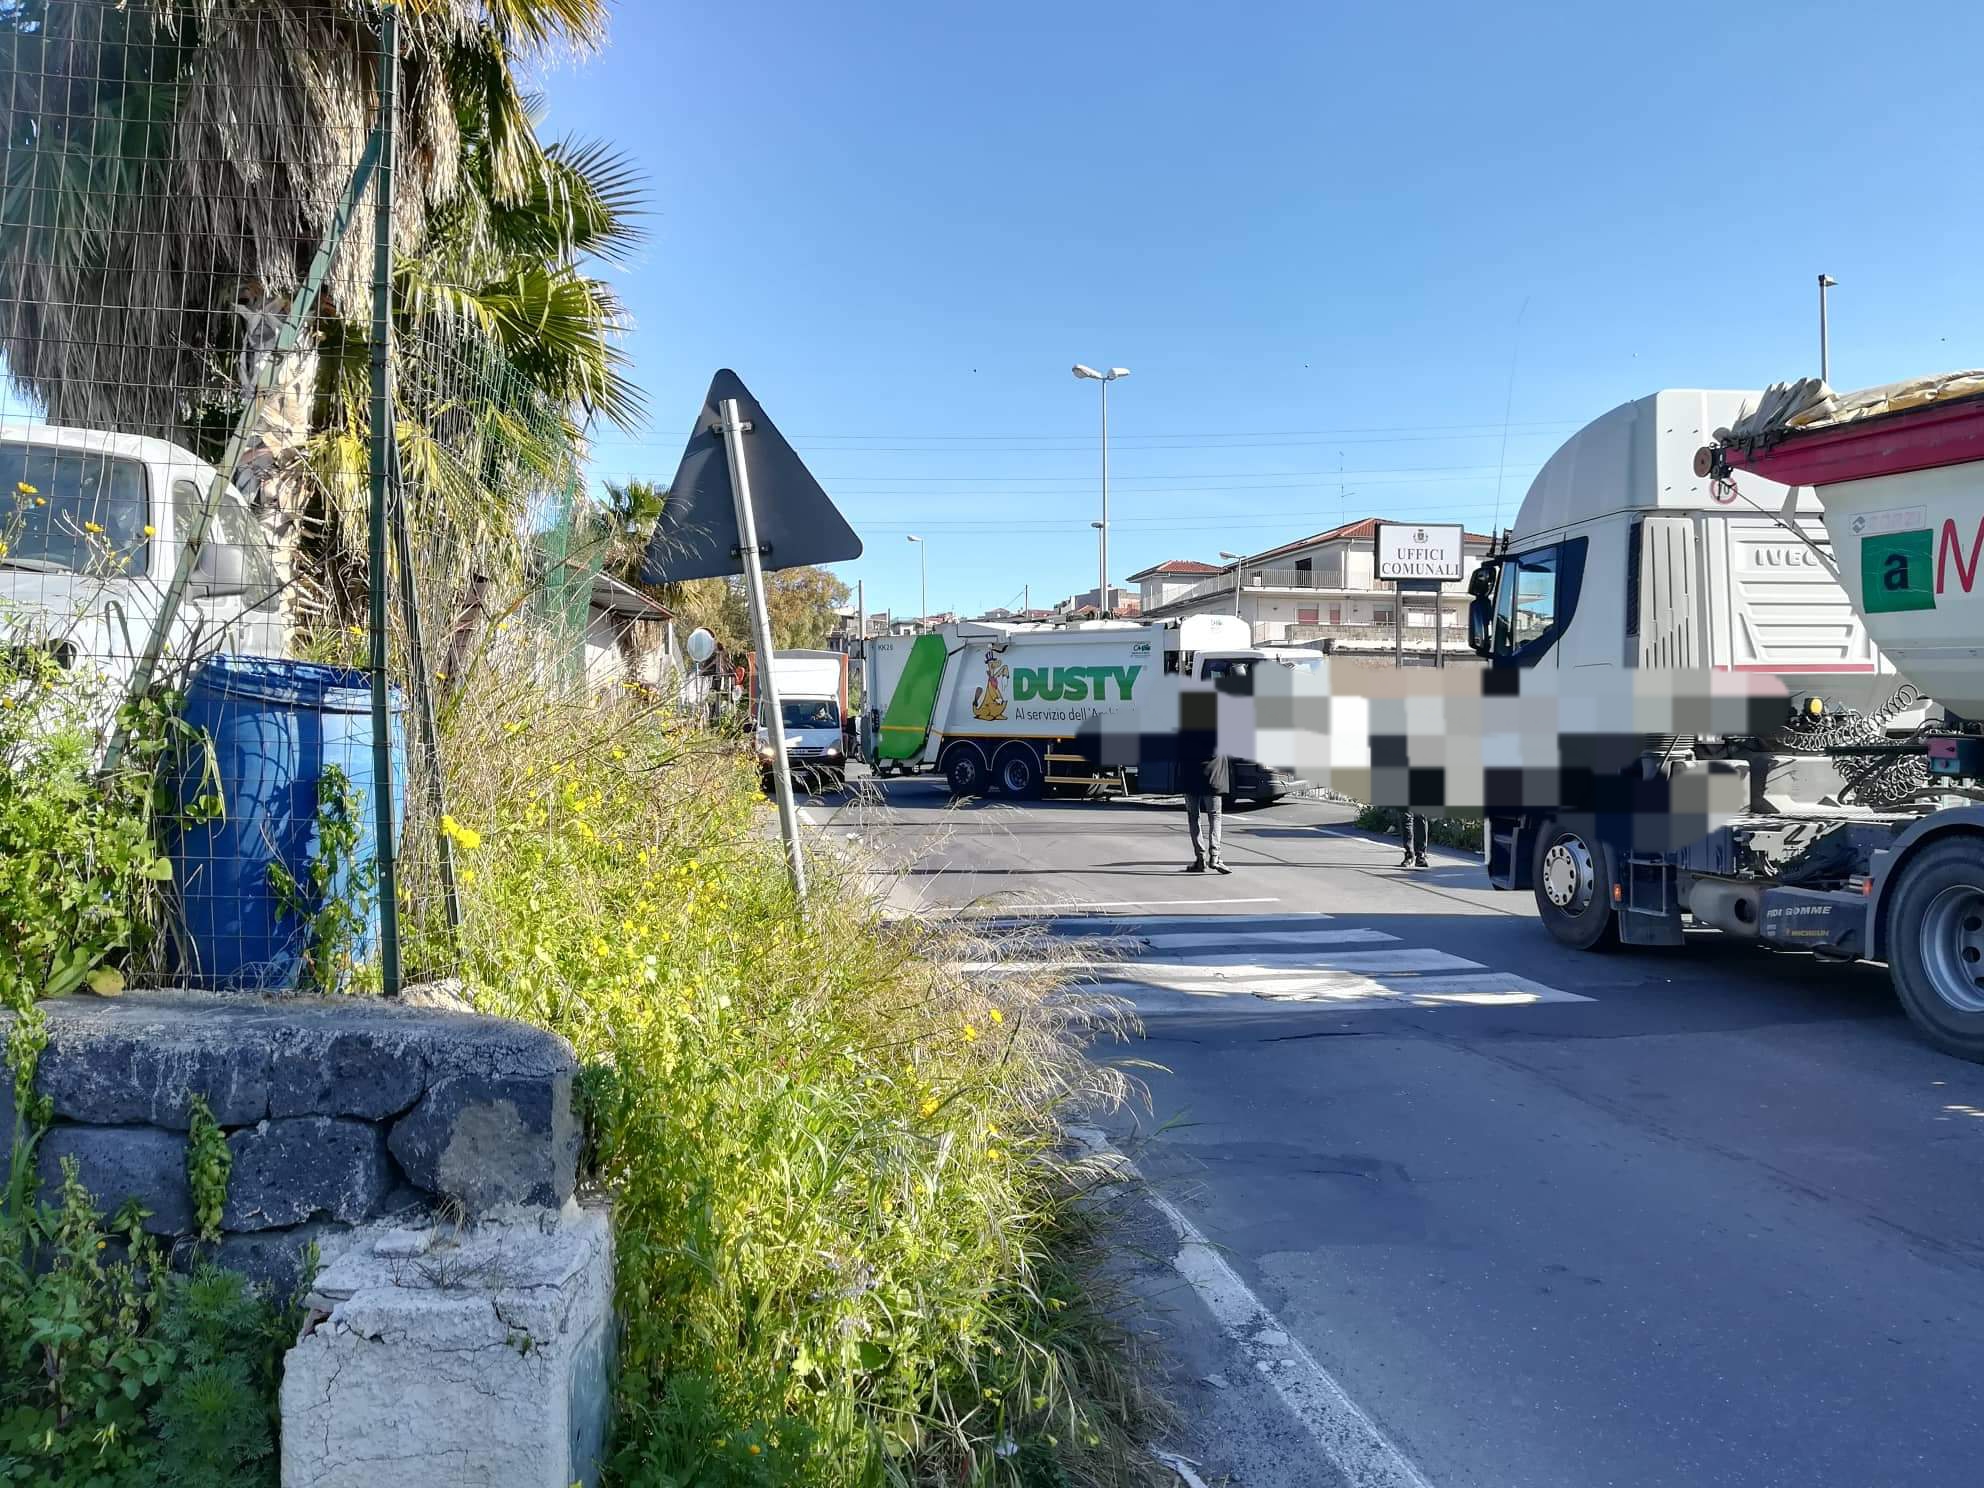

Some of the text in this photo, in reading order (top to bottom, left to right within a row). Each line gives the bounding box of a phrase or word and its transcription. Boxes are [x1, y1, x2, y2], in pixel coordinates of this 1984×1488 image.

[1397, 548, 1444, 560] UFFICI
[1755, 549, 1818, 566] IVEC
[1382, 562, 1459, 575] COMUNALI
[1883, 553, 1909, 591] a
[1013, 665, 1142, 701] DUSTY
[1015, 707, 1025, 720] Al
[1027, 708, 1066, 721] servizio
[1785, 906, 1832, 916] GOMME
